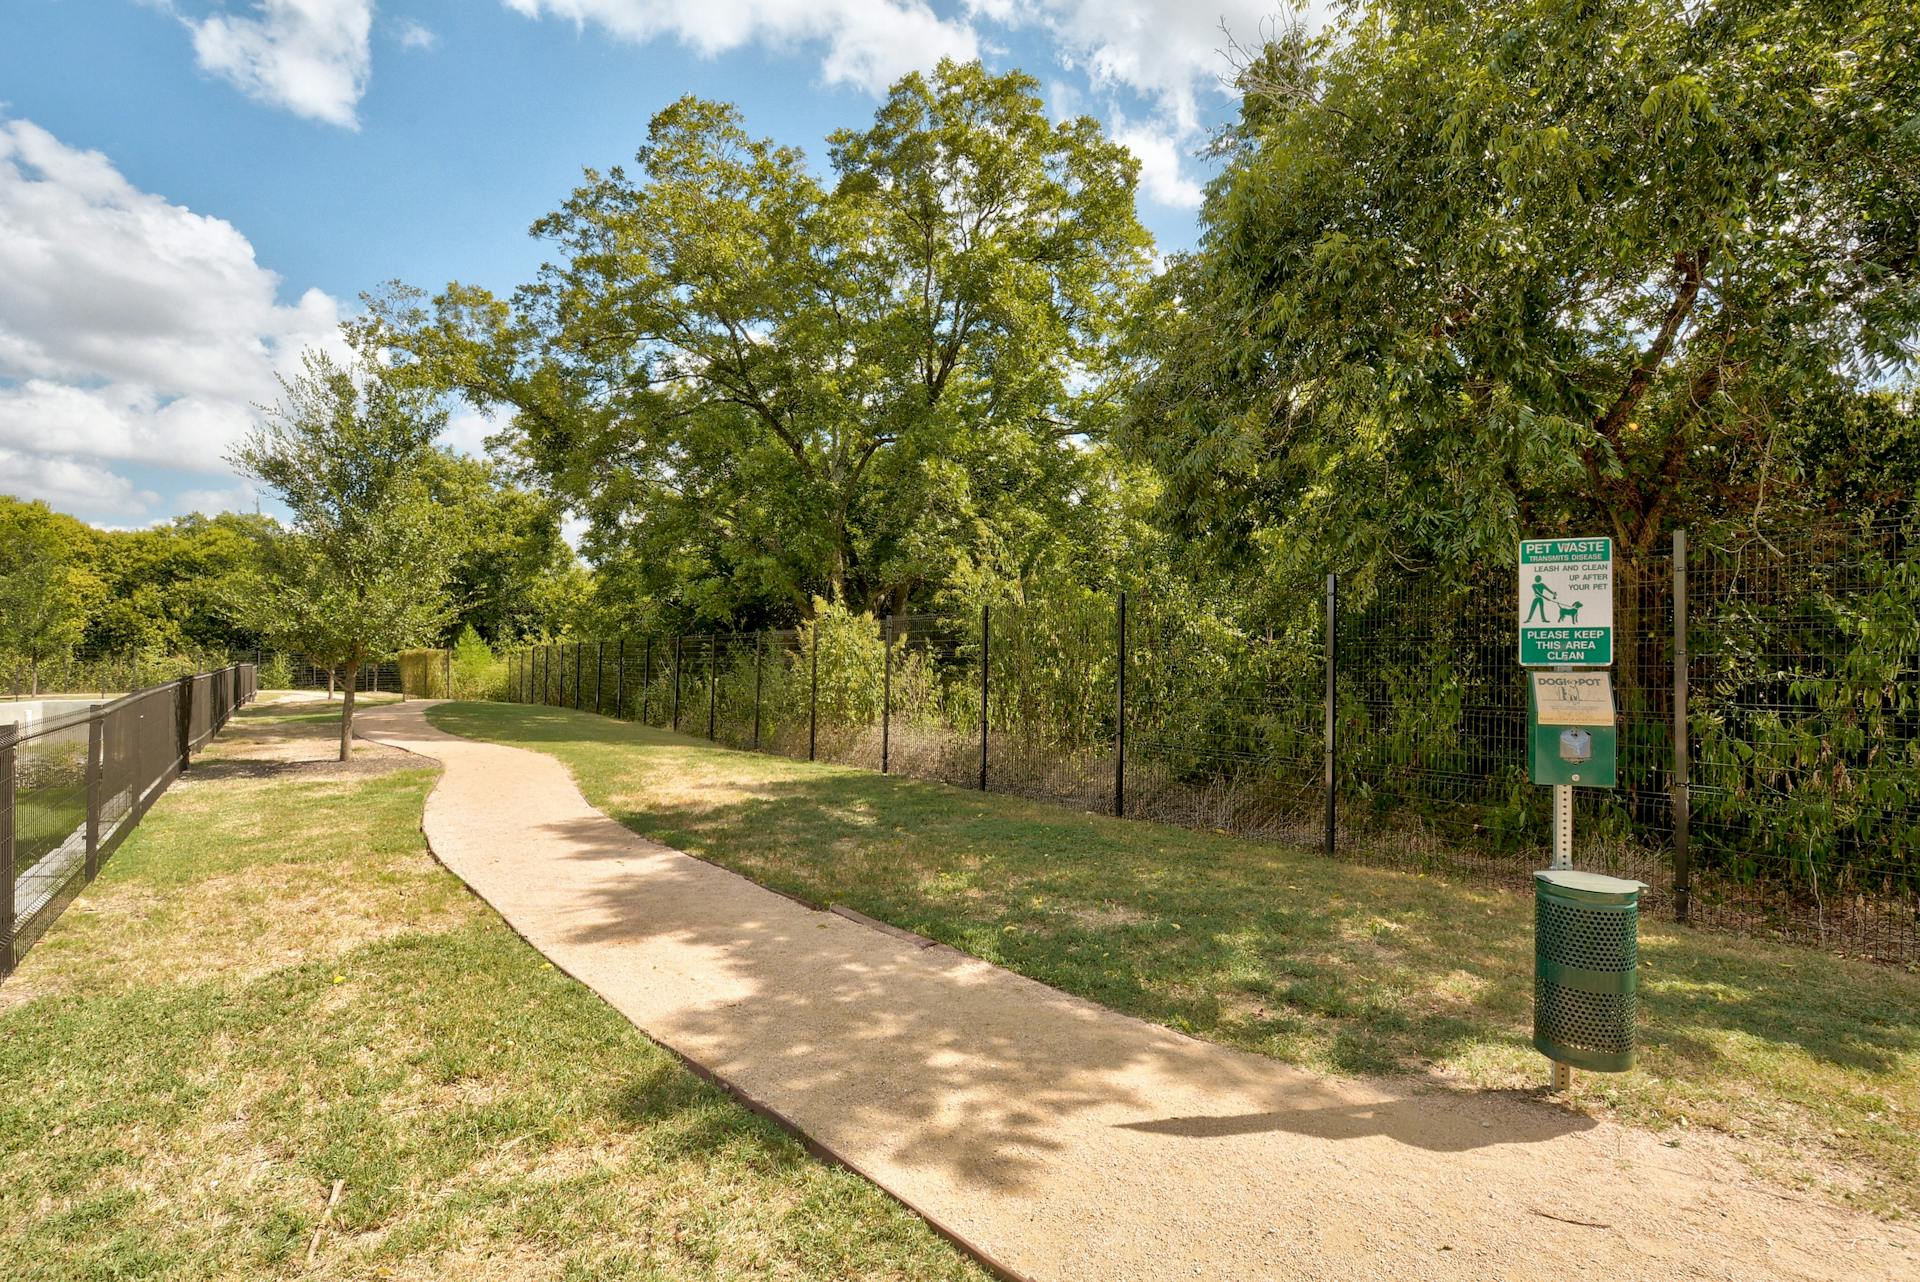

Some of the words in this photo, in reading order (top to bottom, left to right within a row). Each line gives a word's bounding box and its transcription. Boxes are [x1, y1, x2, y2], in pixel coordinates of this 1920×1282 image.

[1526, 543, 1552, 554] PET
[1557, 541, 1604, 553] WASTE
[1527, 630, 1569, 639] PLEASE
[1574, 630, 1604, 639] KEEP
[1536, 641, 1560, 649] THIS
[1565, 641, 1596, 649] AREA
[1547, 651, 1584, 660] CLEAN
